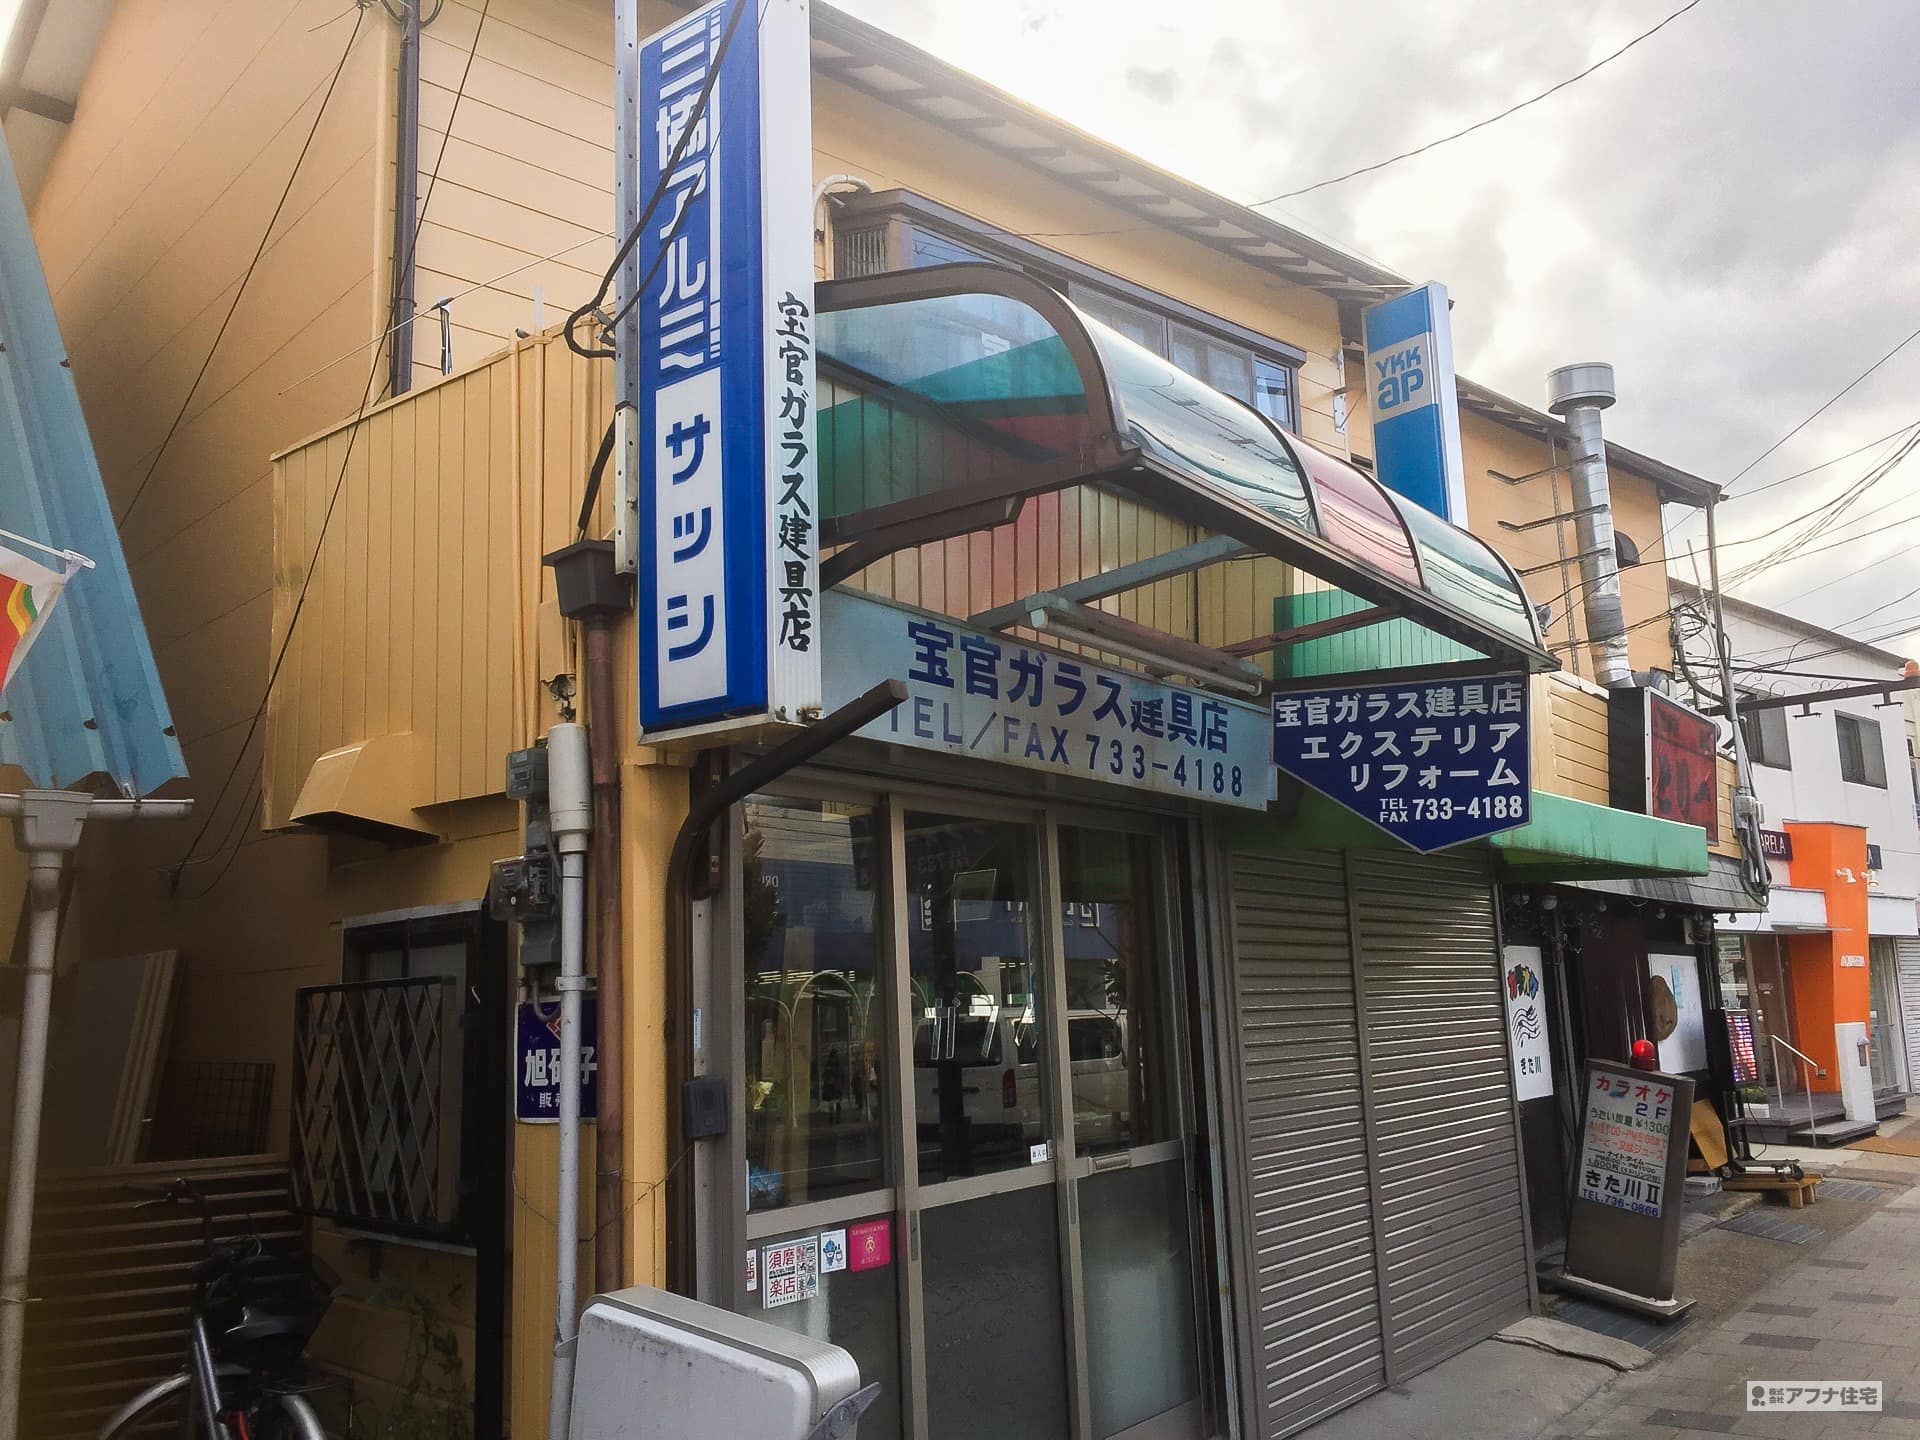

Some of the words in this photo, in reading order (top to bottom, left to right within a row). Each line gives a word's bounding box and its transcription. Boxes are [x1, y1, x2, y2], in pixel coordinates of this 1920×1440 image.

[1376, 346, 1421, 378] YKK
[775, 291, 813, 653] 宝官ガラス建具店
[665, 413, 715, 662] サッシ
[907, 621, 1229, 754] 宝官ガラス建具店
[1275, 681, 1523, 728] 宝官ガラス建具店
[1301, 722, 1521, 760] エクステリア
[1085, 733, 1243, 797] 733-4188
[1349, 758, 1521, 793] リフォーム
[1379, 798, 1408, 811] TEL
[1412, 795, 1524, 822] 733-4188
[1379, 811, 1409, 823] FAX
[1520, 1055, 1542, 1076] きた川
[1595, 1076, 1671, 1104] カラオケ
[769, 1248, 796, 1269] 須磨
[769, 1277, 796, 1298] 楽店
